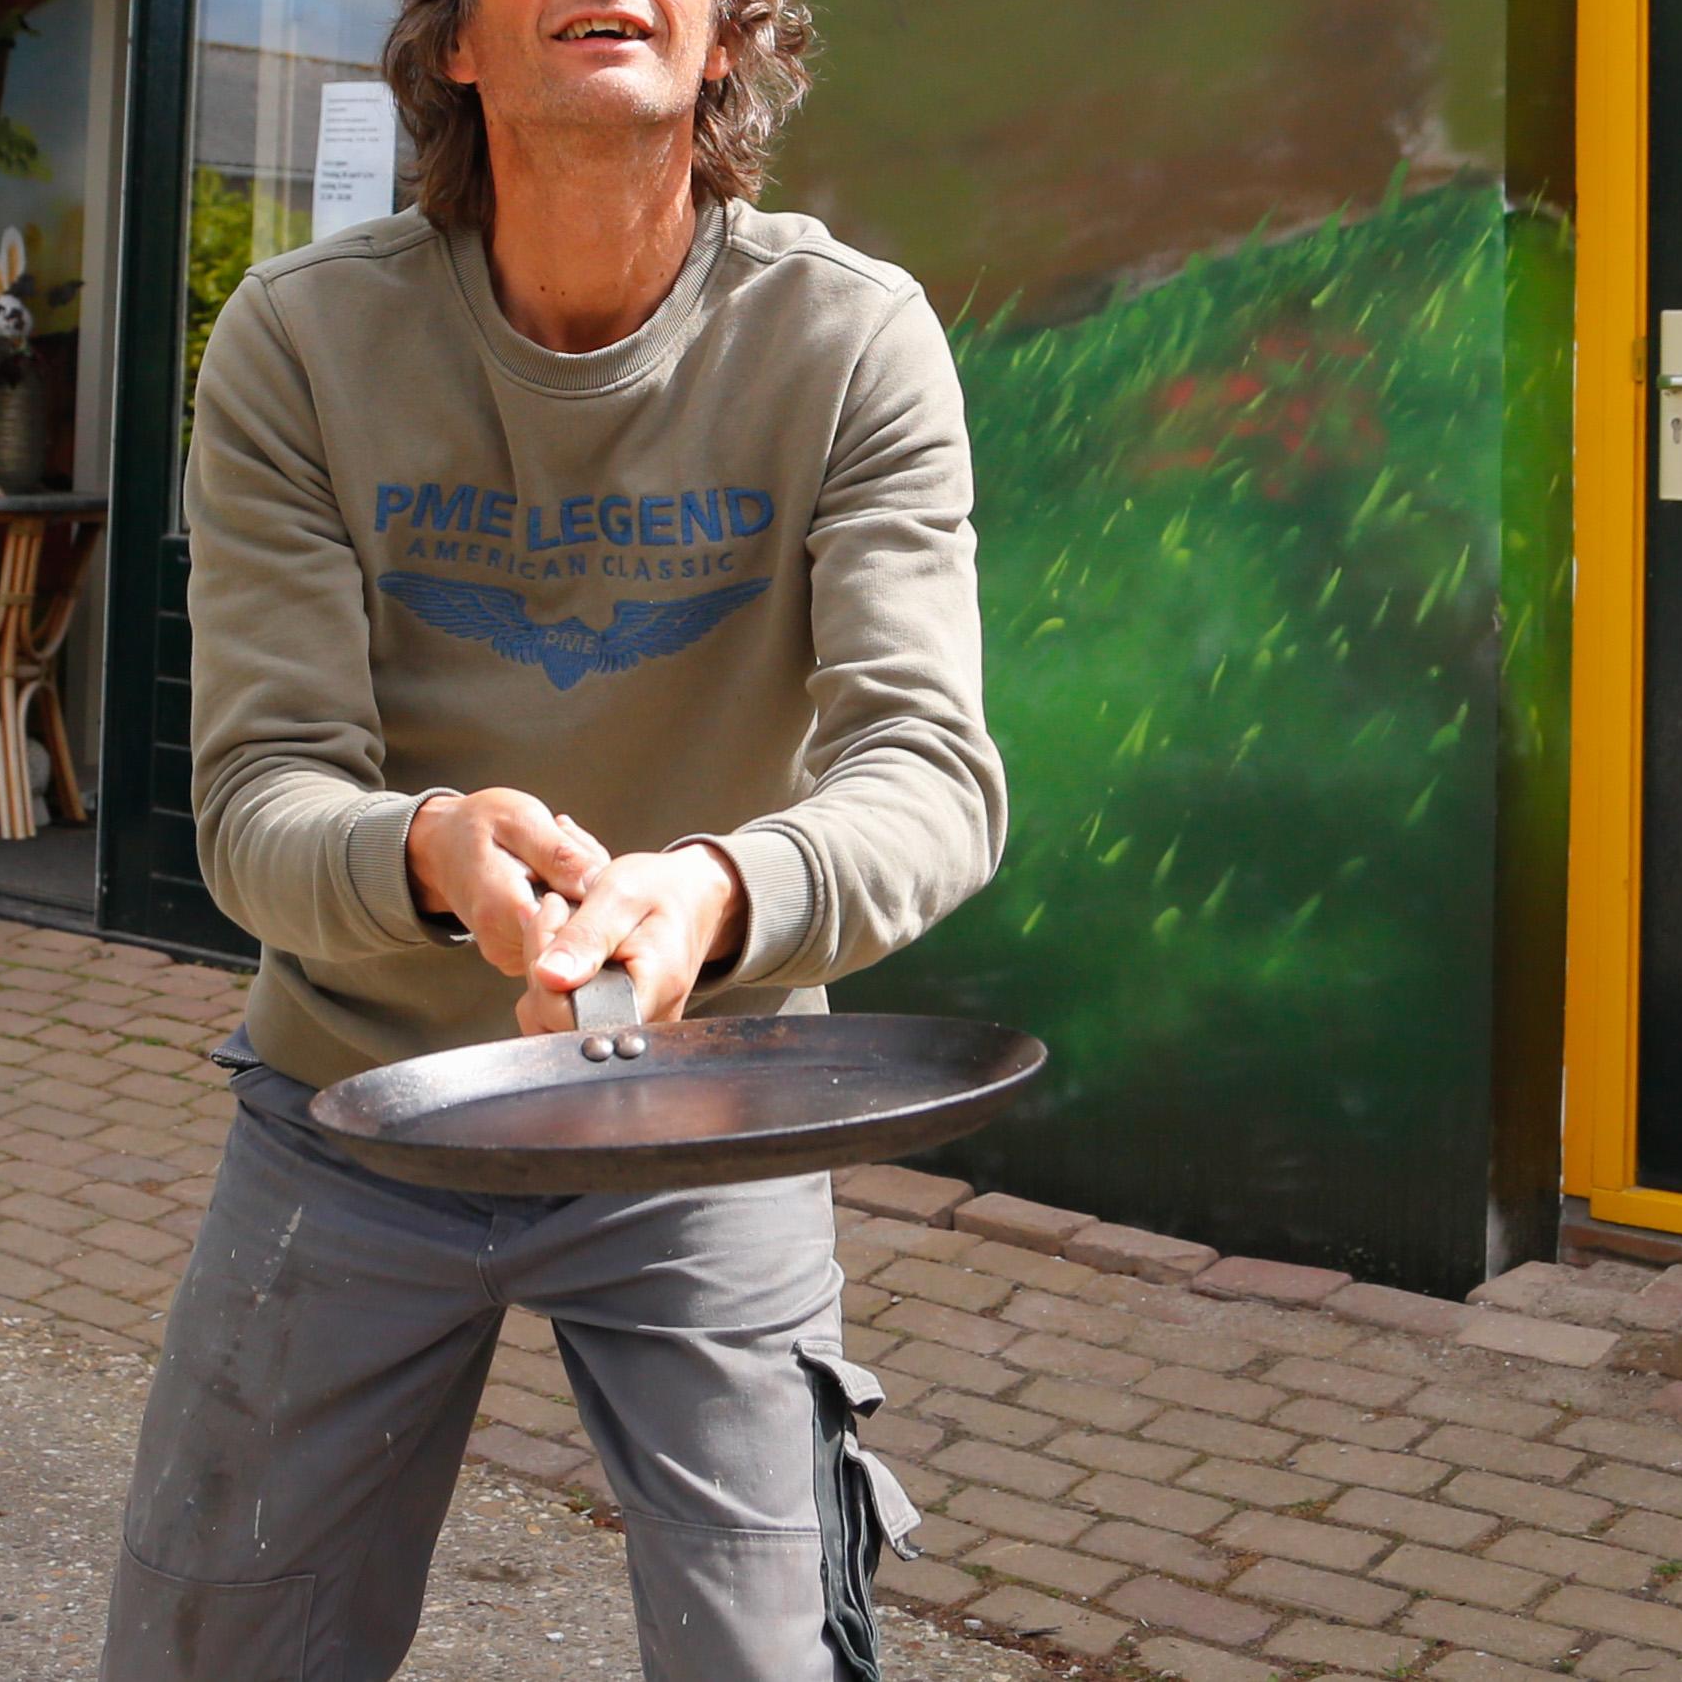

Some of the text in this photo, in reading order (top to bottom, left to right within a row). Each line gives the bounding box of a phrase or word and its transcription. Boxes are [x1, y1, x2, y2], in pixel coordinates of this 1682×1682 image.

[374, 481, 775, 552] PME LEGEND
[406, 536, 735, 582] AMERICAN CLASSIC
